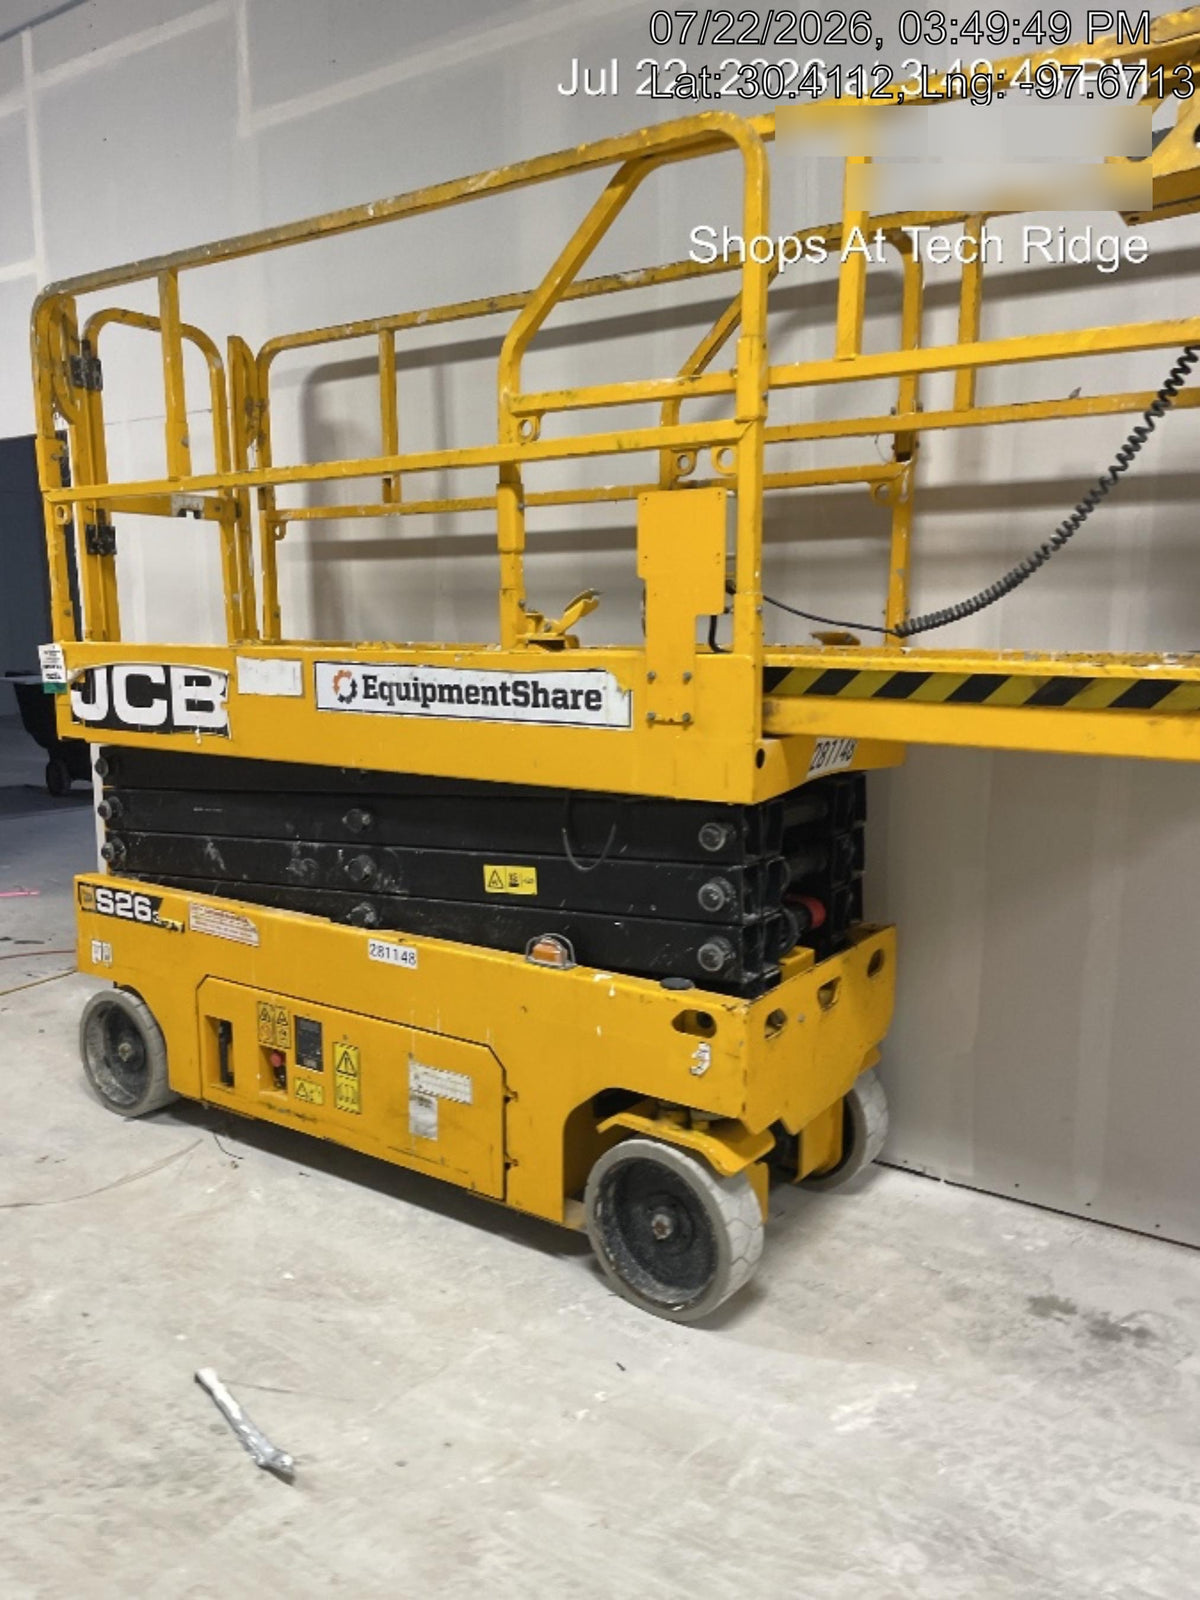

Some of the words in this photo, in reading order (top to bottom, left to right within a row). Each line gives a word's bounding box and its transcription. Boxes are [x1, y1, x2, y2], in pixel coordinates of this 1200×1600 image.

[71, 665, 229, 729] JCB
[361, 674, 602, 711] EquipmentShare
[369, 943, 417, 966] 281148
